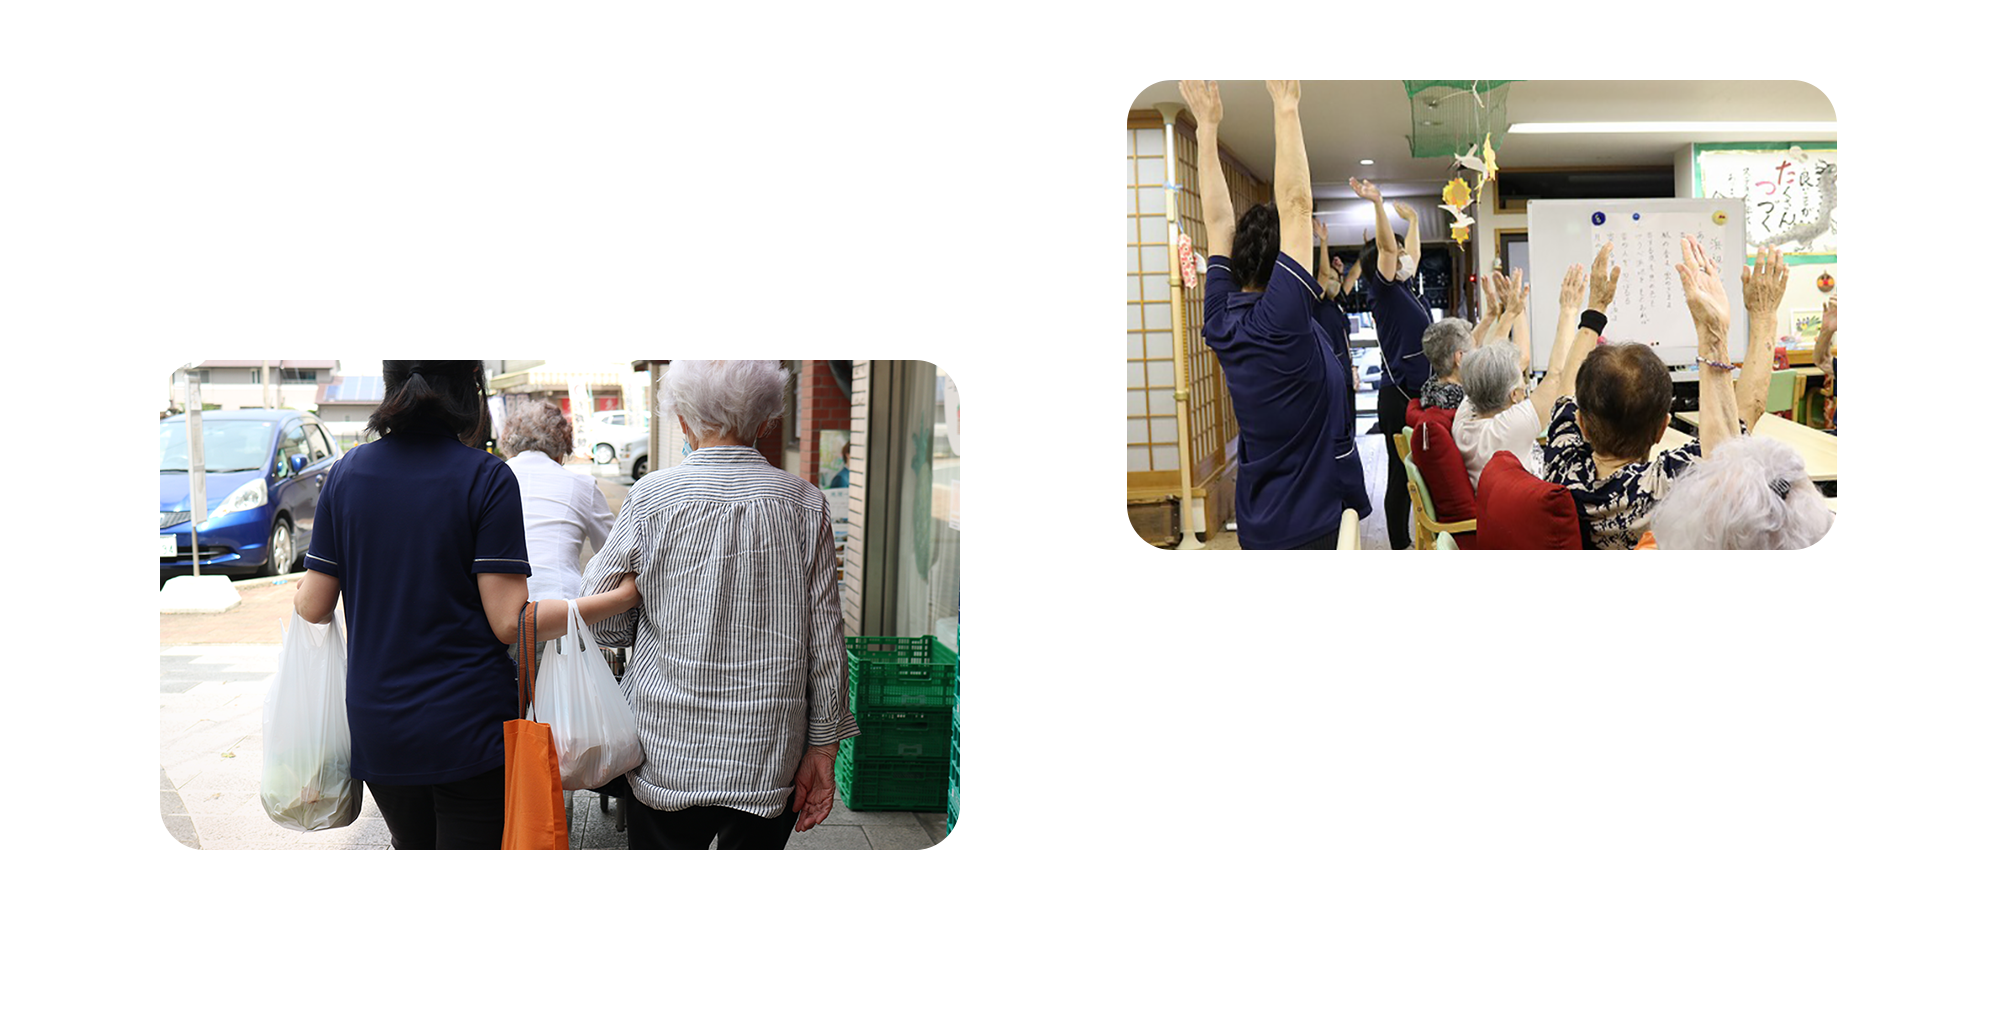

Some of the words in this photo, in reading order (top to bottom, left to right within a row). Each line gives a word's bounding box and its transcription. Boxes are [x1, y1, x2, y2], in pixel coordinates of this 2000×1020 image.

[1755, 180, 1780, 233] つづく
[1775, 160, 1796, 228] たくさん
